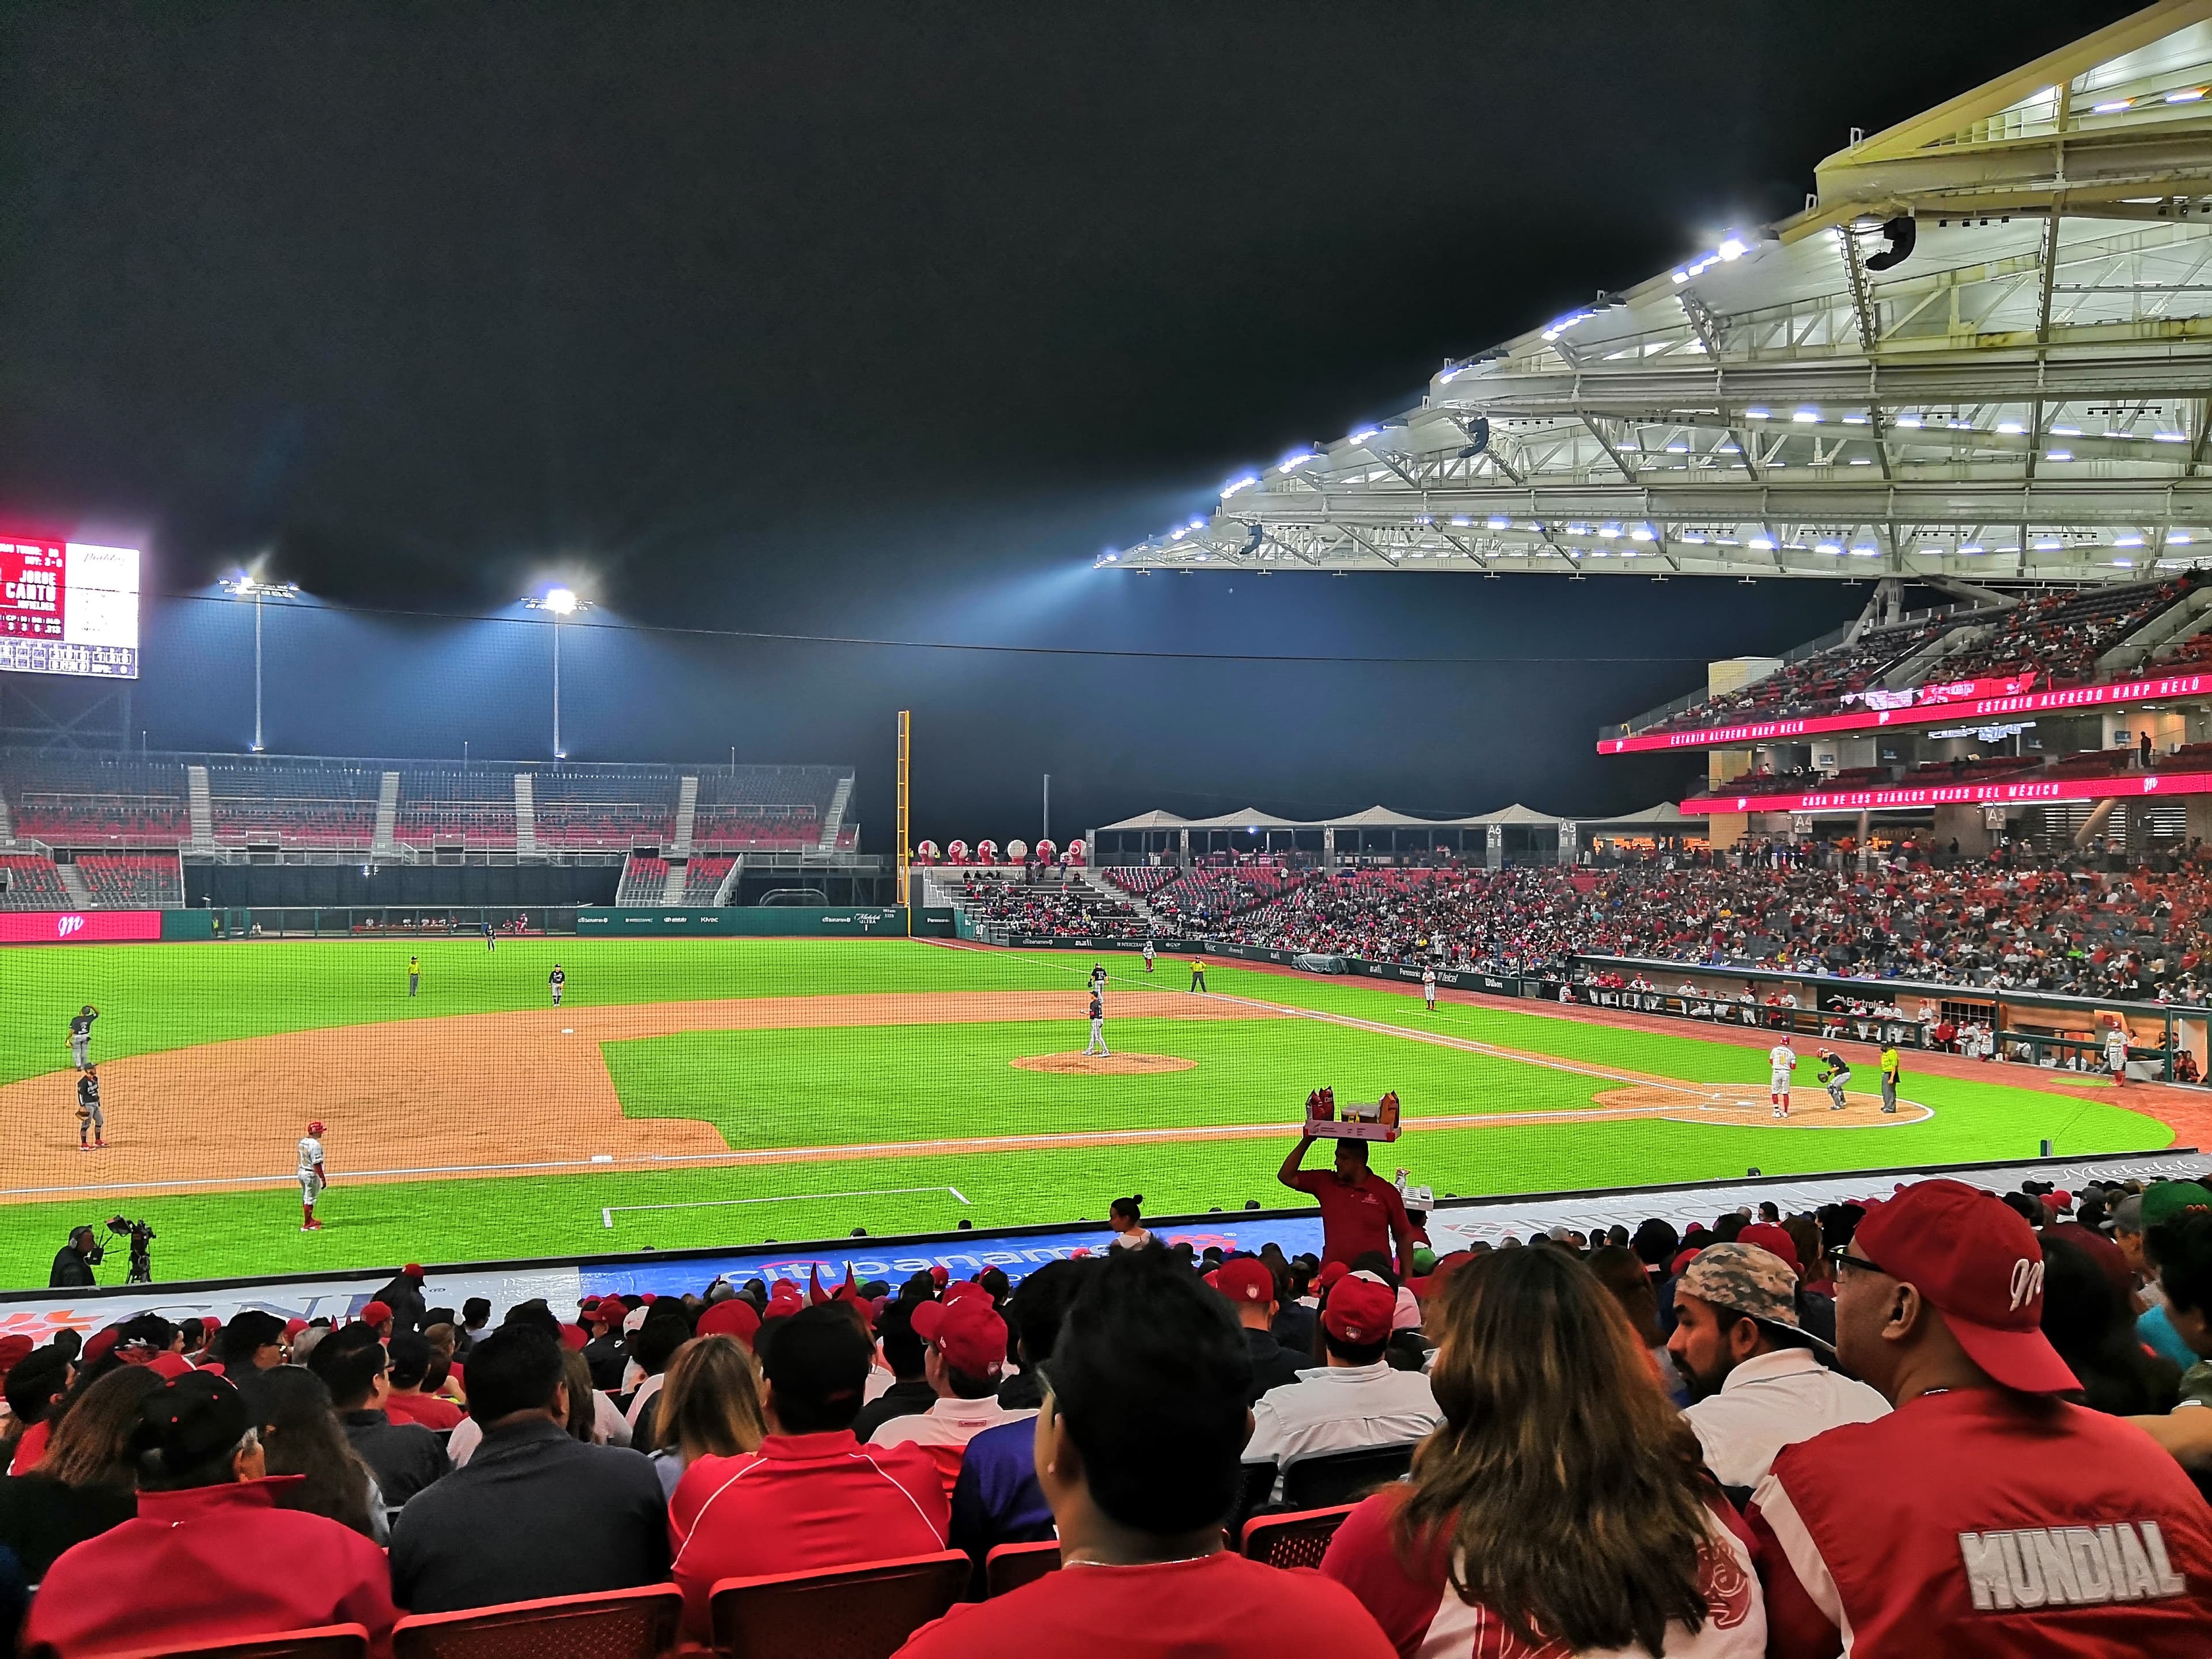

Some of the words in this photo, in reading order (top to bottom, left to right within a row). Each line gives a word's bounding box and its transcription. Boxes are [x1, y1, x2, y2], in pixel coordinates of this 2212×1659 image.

[1976, 696, 2032, 713] ESTADIO
[2040, 688, 2103, 707] ALFREDO
[2112, 683, 2150, 699] HARP
[2161, 676, 2200, 694] HELÚ
[1671, 733, 1705, 745] ESTADIO
[1709, 728, 1747, 741] ALFREDO
[1752, 725, 1775, 737] HARP
[1802, 796, 1827, 806] CASA
[1832, 795, 1846, 805] DE
[1850, 793, 1871, 805] LOS
[1877, 790, 1926, 803] DIABLOS
[1931, 787, 1969, 800] ROJOS
[1978, 786, 2000, 799] DEL
[2008, 783, 2059, 797] MÉXICO
[1988, 808, 2005, 821] A3
[1560, 822, 1576, 832] A5
[1796, 815, 1812, 827] A4
[1325, 827, 1334, 836] A7
[1488, 824, 1501, 835] A6
[1399, 967, 1421, 978] Panasonic
[1484, 978, 1503, 988] Wilson
[1959, 1521, 2187, 1610] MUNDIAL
